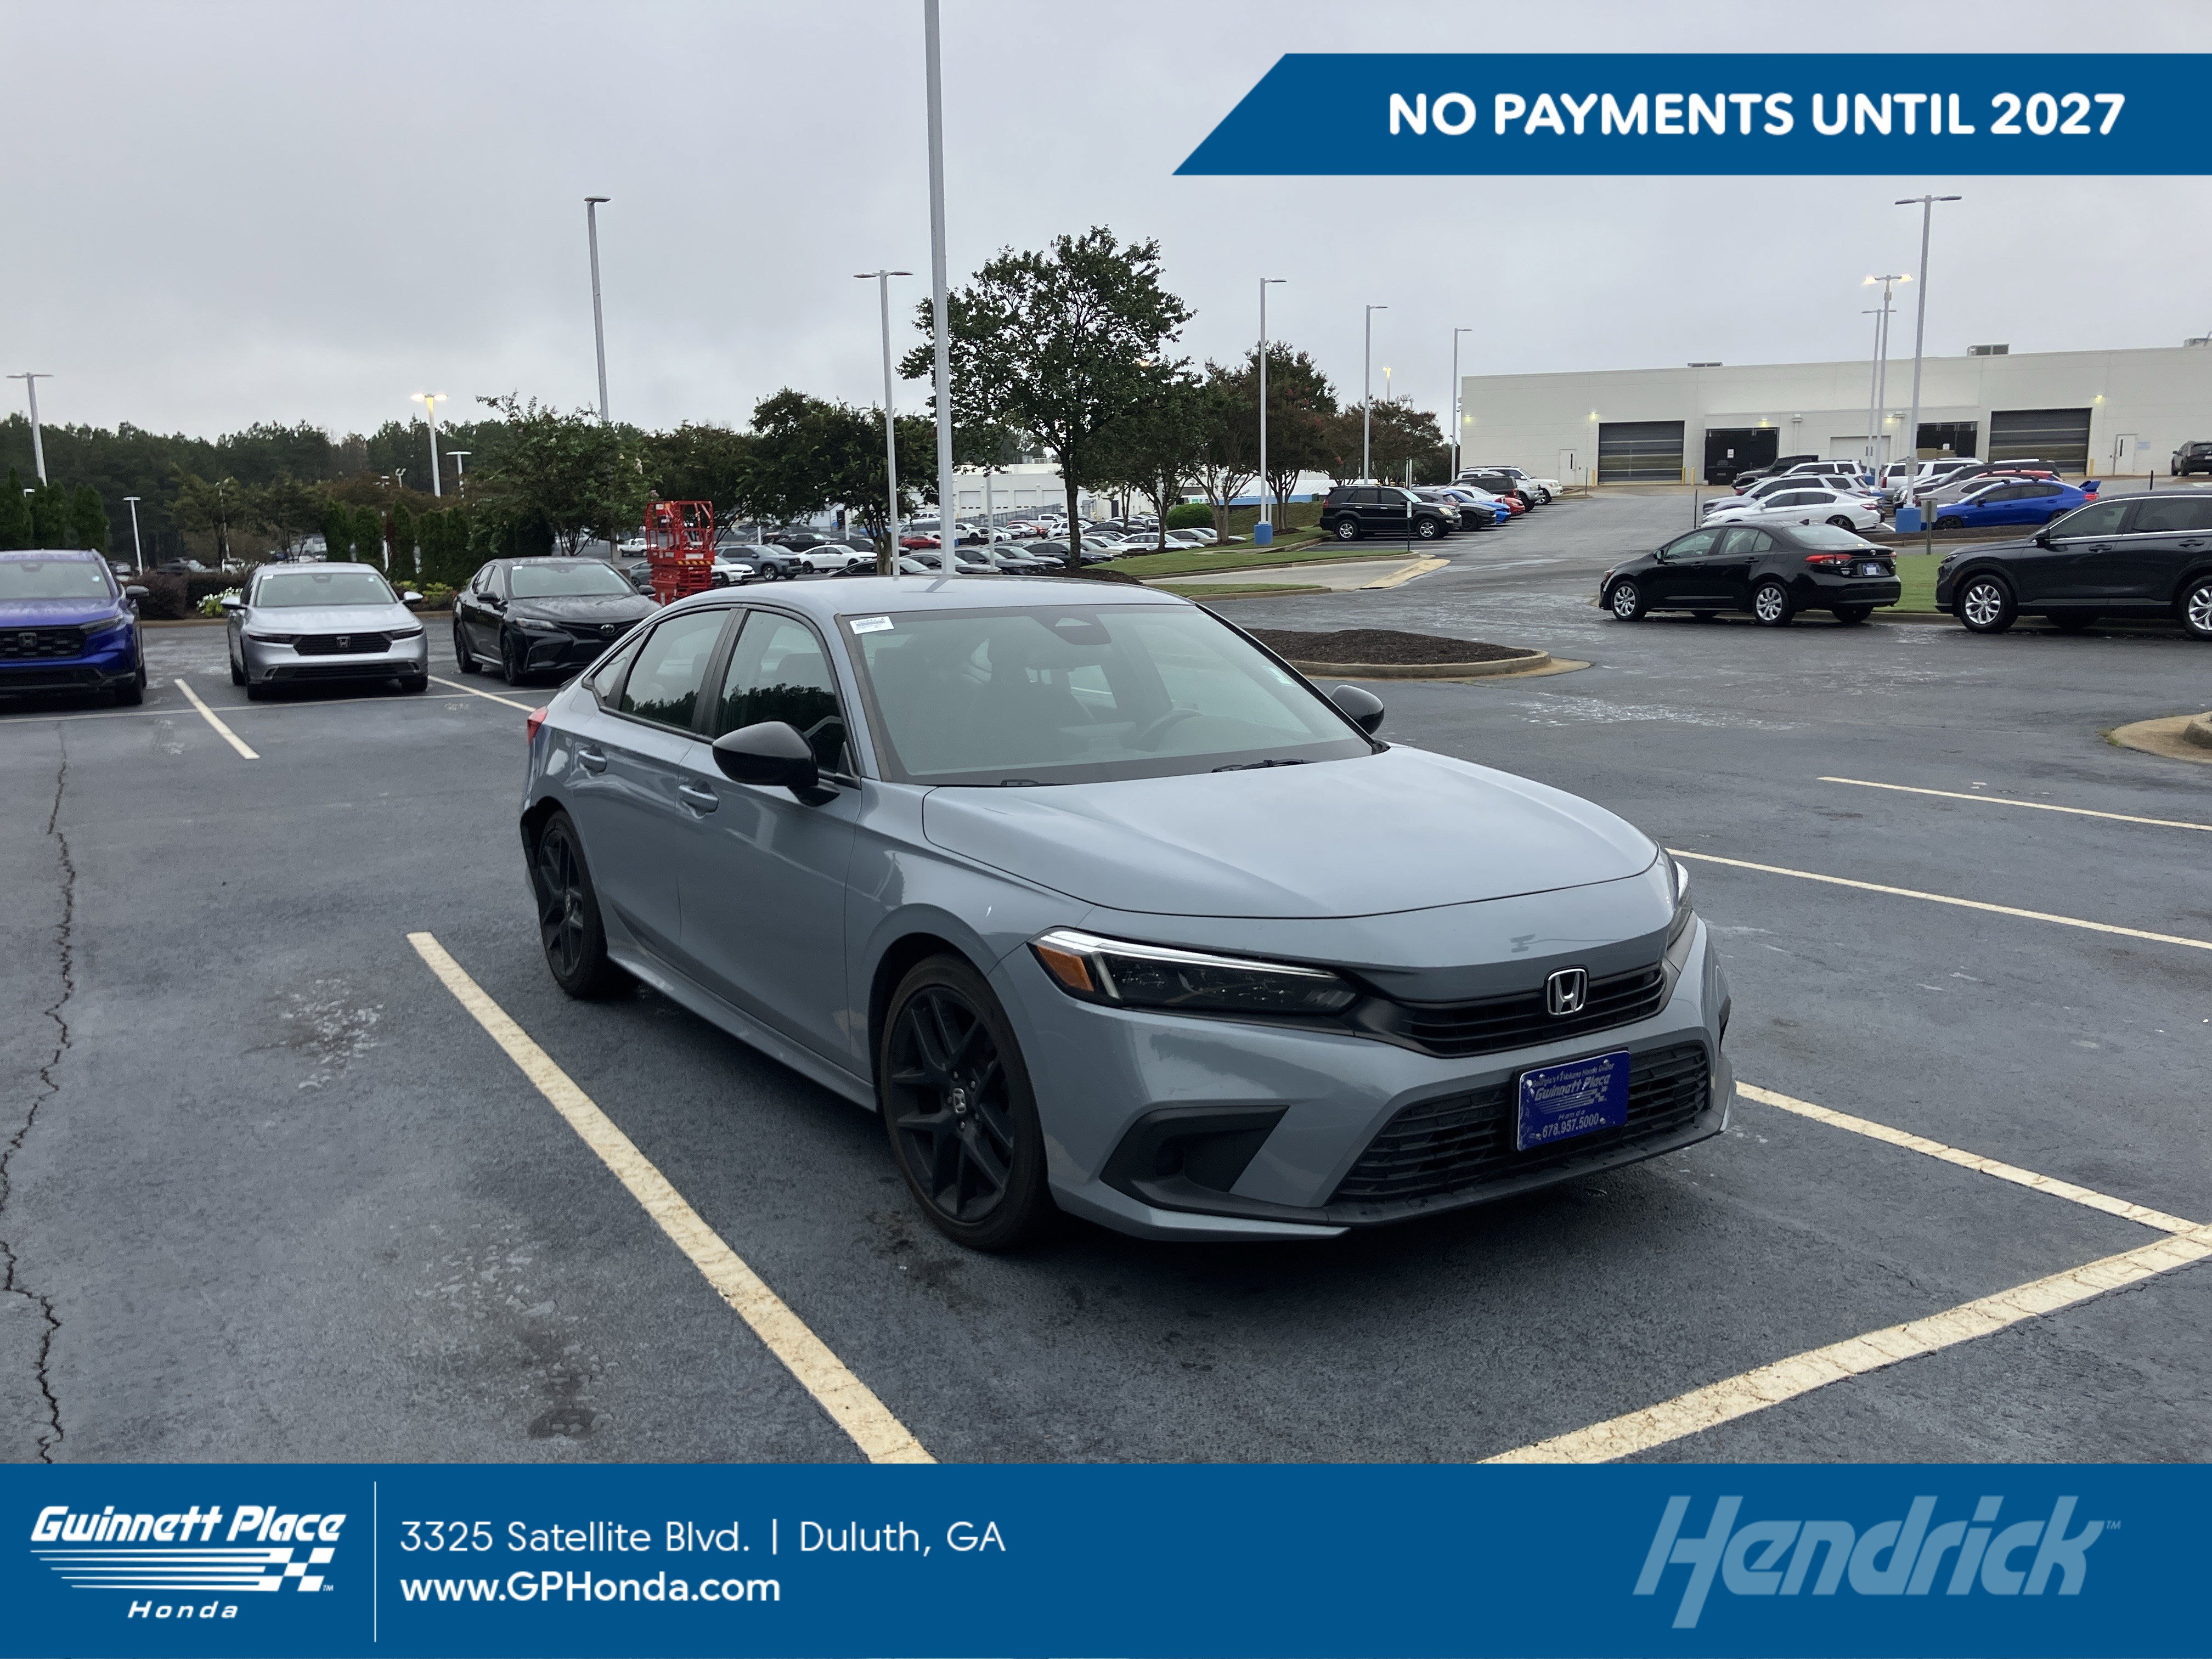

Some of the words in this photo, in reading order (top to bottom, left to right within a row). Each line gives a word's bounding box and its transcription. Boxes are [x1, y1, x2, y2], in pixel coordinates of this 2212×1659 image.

[1534, 1079, 1582, 1101] Gwinnett
[1582, 1074, 1611, 1091] Place
[1542, 1112, 1600, 1139] 678.957.5000
[1558, 1109, 1585, 1121] Honda
